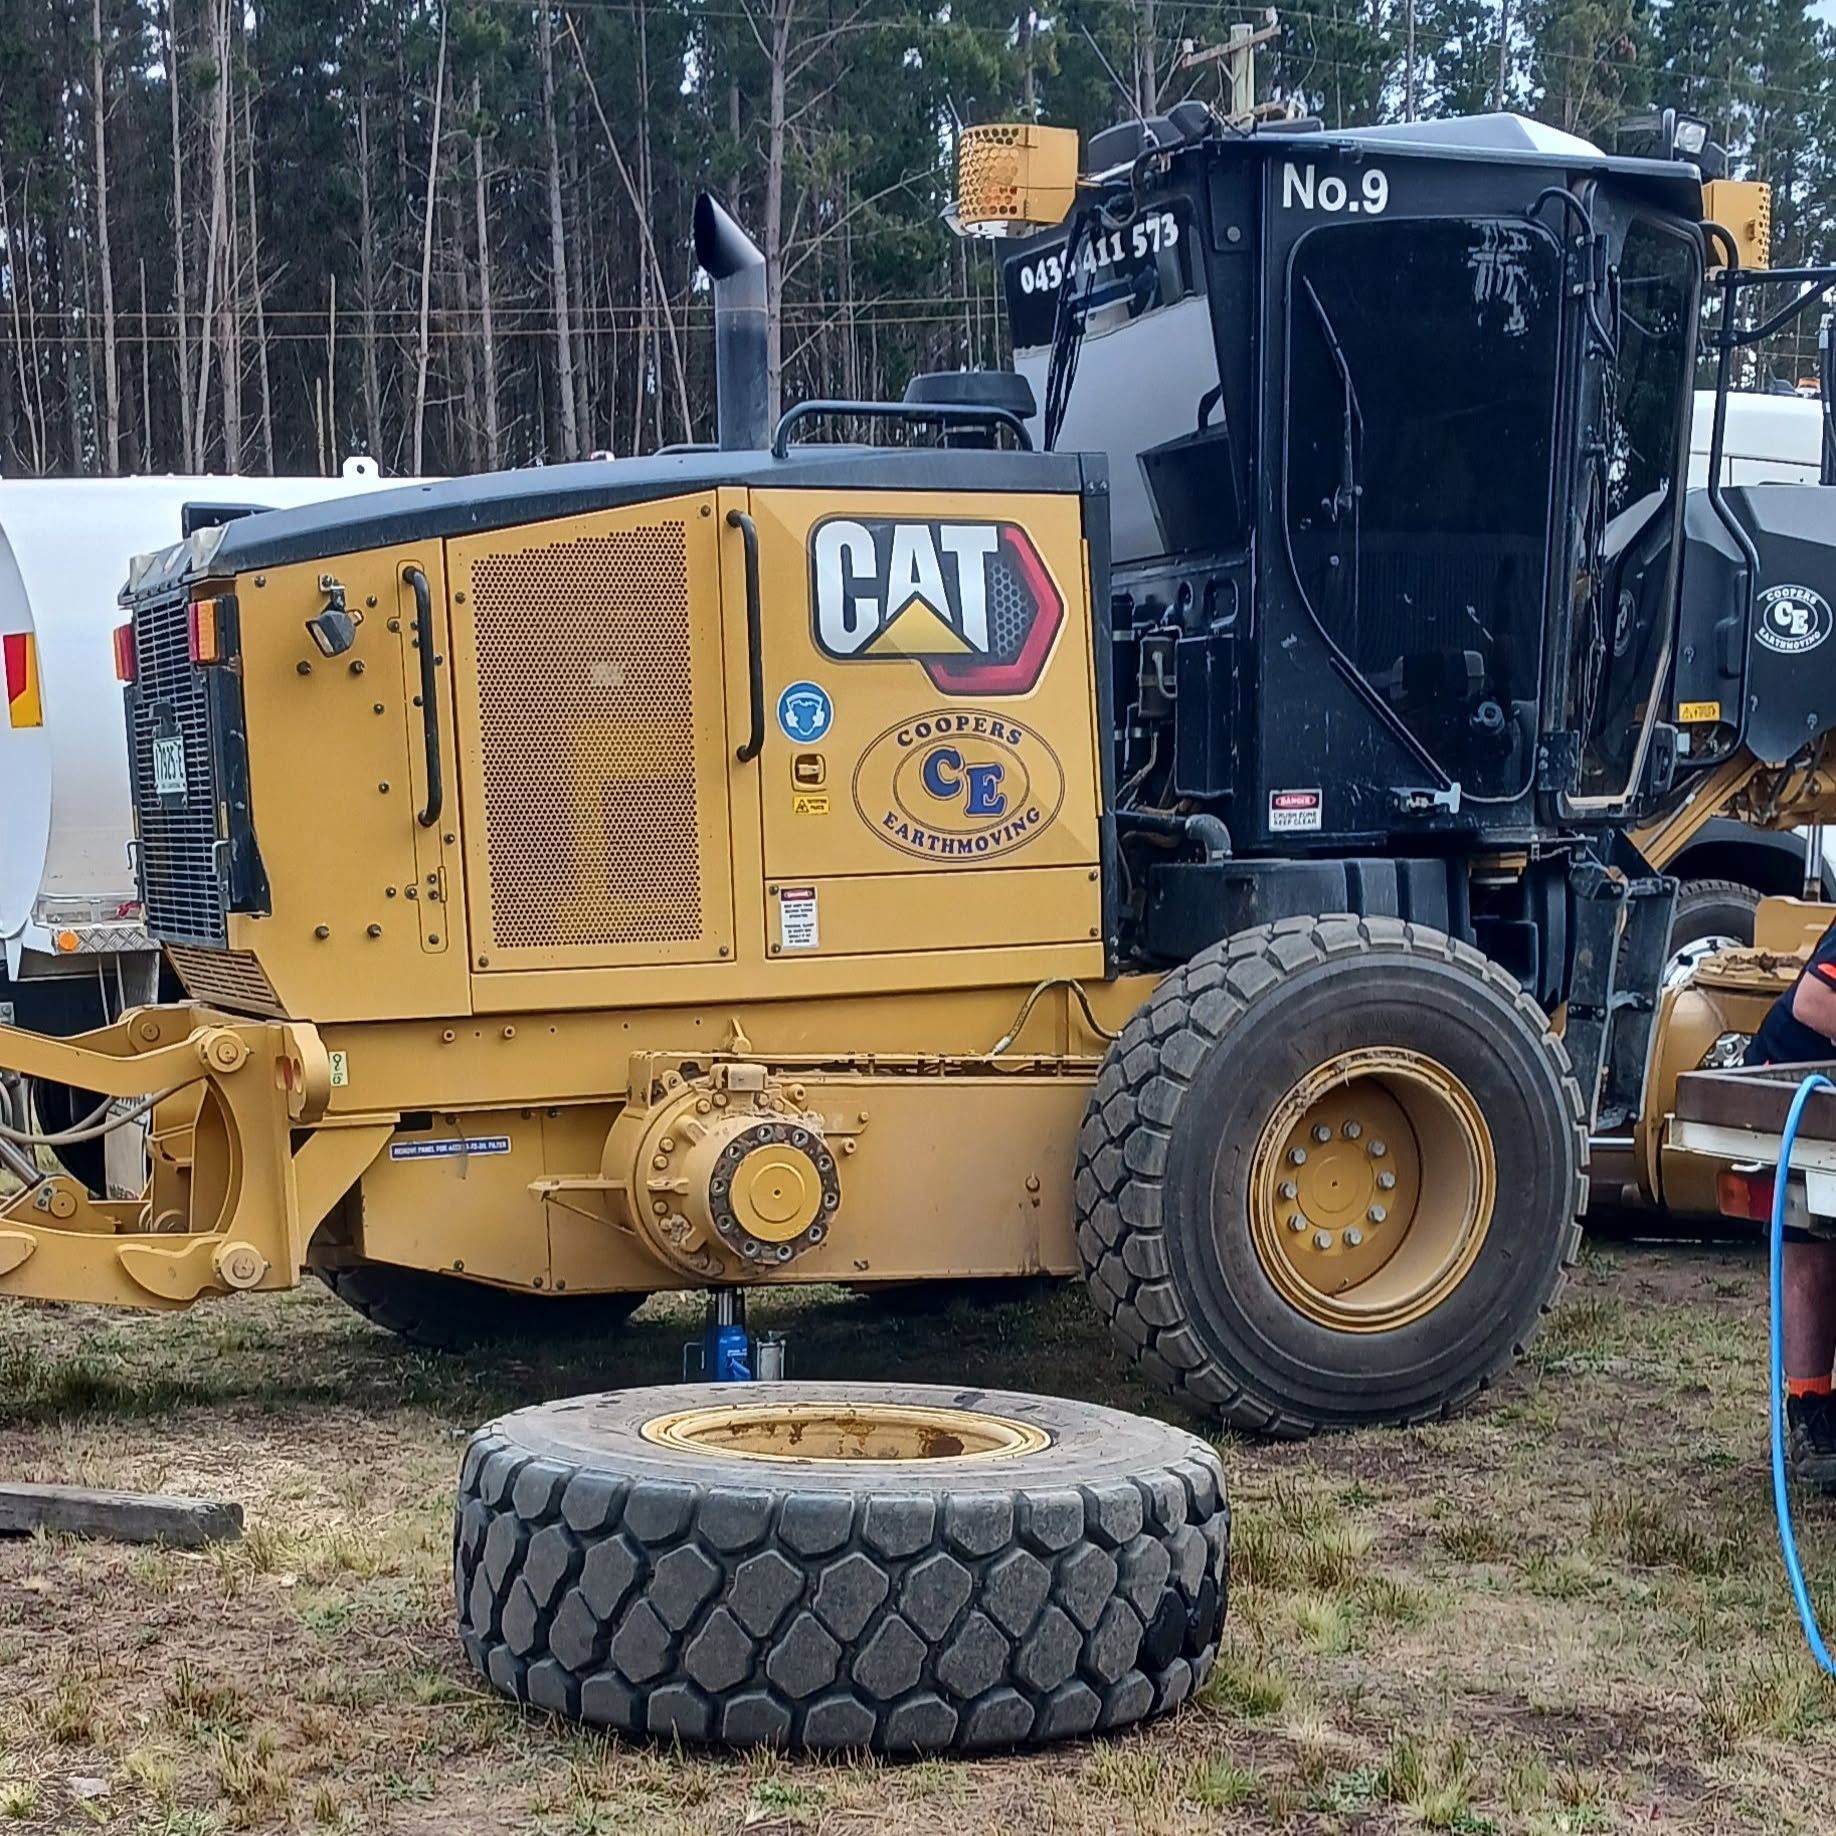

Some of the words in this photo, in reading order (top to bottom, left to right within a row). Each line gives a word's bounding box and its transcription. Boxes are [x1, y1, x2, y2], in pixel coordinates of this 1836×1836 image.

[1283, 162, 1388, 214] No.9
[1083, 231, 1126, 274] 411
[1132, 212, 1179, 258] 573
[815, 520, 998, 653] CAT
[1766, 588, 1817, 604] COOPERS
[1759, 627, 1821, 649] EARTHMOVING
[1774, 601, 1808, 634] CE
[897, 715, 1022, 747] COOPERS
[921, 746, 1006, 816] CE
[882, 806, 1040, 854] EARTHMOVING
